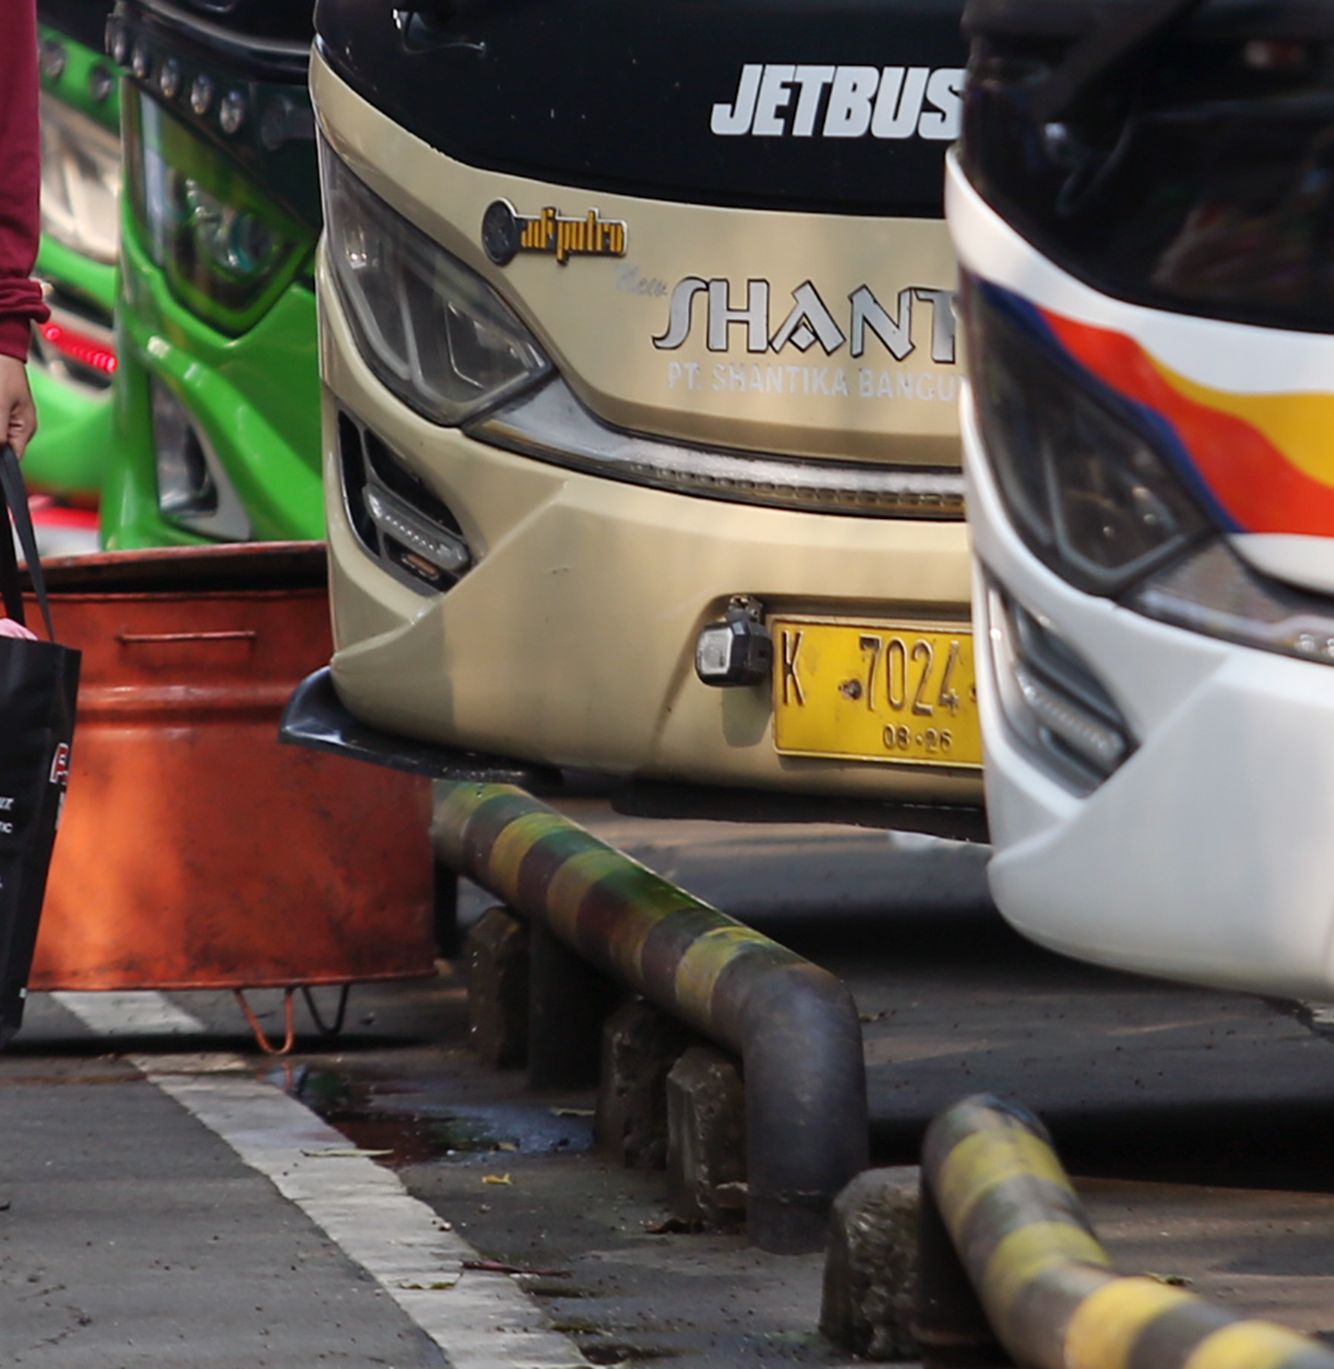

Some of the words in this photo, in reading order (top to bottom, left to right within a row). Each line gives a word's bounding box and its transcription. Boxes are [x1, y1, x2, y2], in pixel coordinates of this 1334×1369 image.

[710, 63, 968, 140] JETBUS
[712, 363, 849, 397] SHANTIKA
[858, 368, 966, 403] BANGU
[780, 631, 806, 707] K
